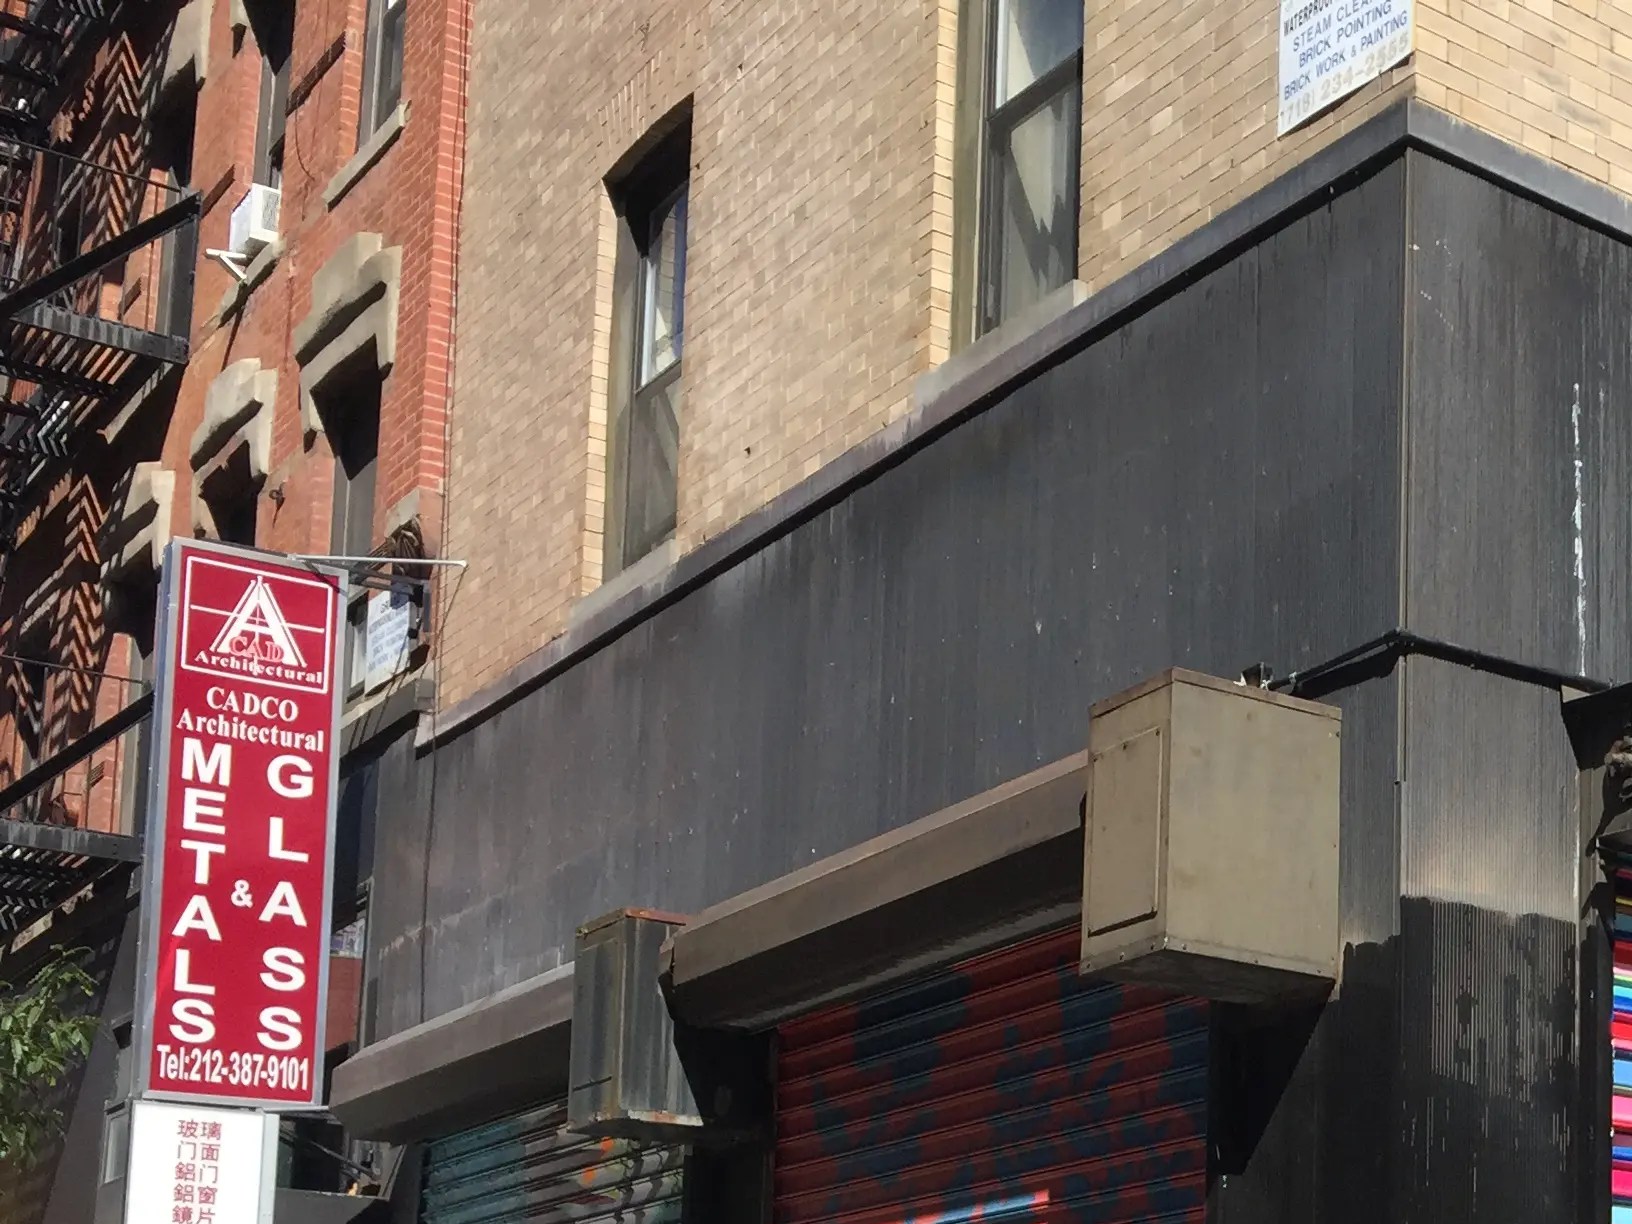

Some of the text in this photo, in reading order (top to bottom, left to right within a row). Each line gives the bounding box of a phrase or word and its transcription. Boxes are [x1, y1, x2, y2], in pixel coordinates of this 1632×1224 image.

[1293, 14, 1332, 52] STEAM
[1299, 0, 1392, 68] BRICK POINTING
[1284, 10, 1408, 100] BRICK WORK & PAINTING
[229, 634, 284, 663] CAD
[194, 650, 322, 685] Architectural
[206, 686, 299, 722] CADCO
[176, 708, 324, 753] Architectural
[169, 737, 232, 1044] METALS
[230, 879, 254, 909] &
[256, 754, 314, 1051] GLASS
[177, 1119, 222, 1140] 玻璃
[177, 1141, 220, 1161] 门面
